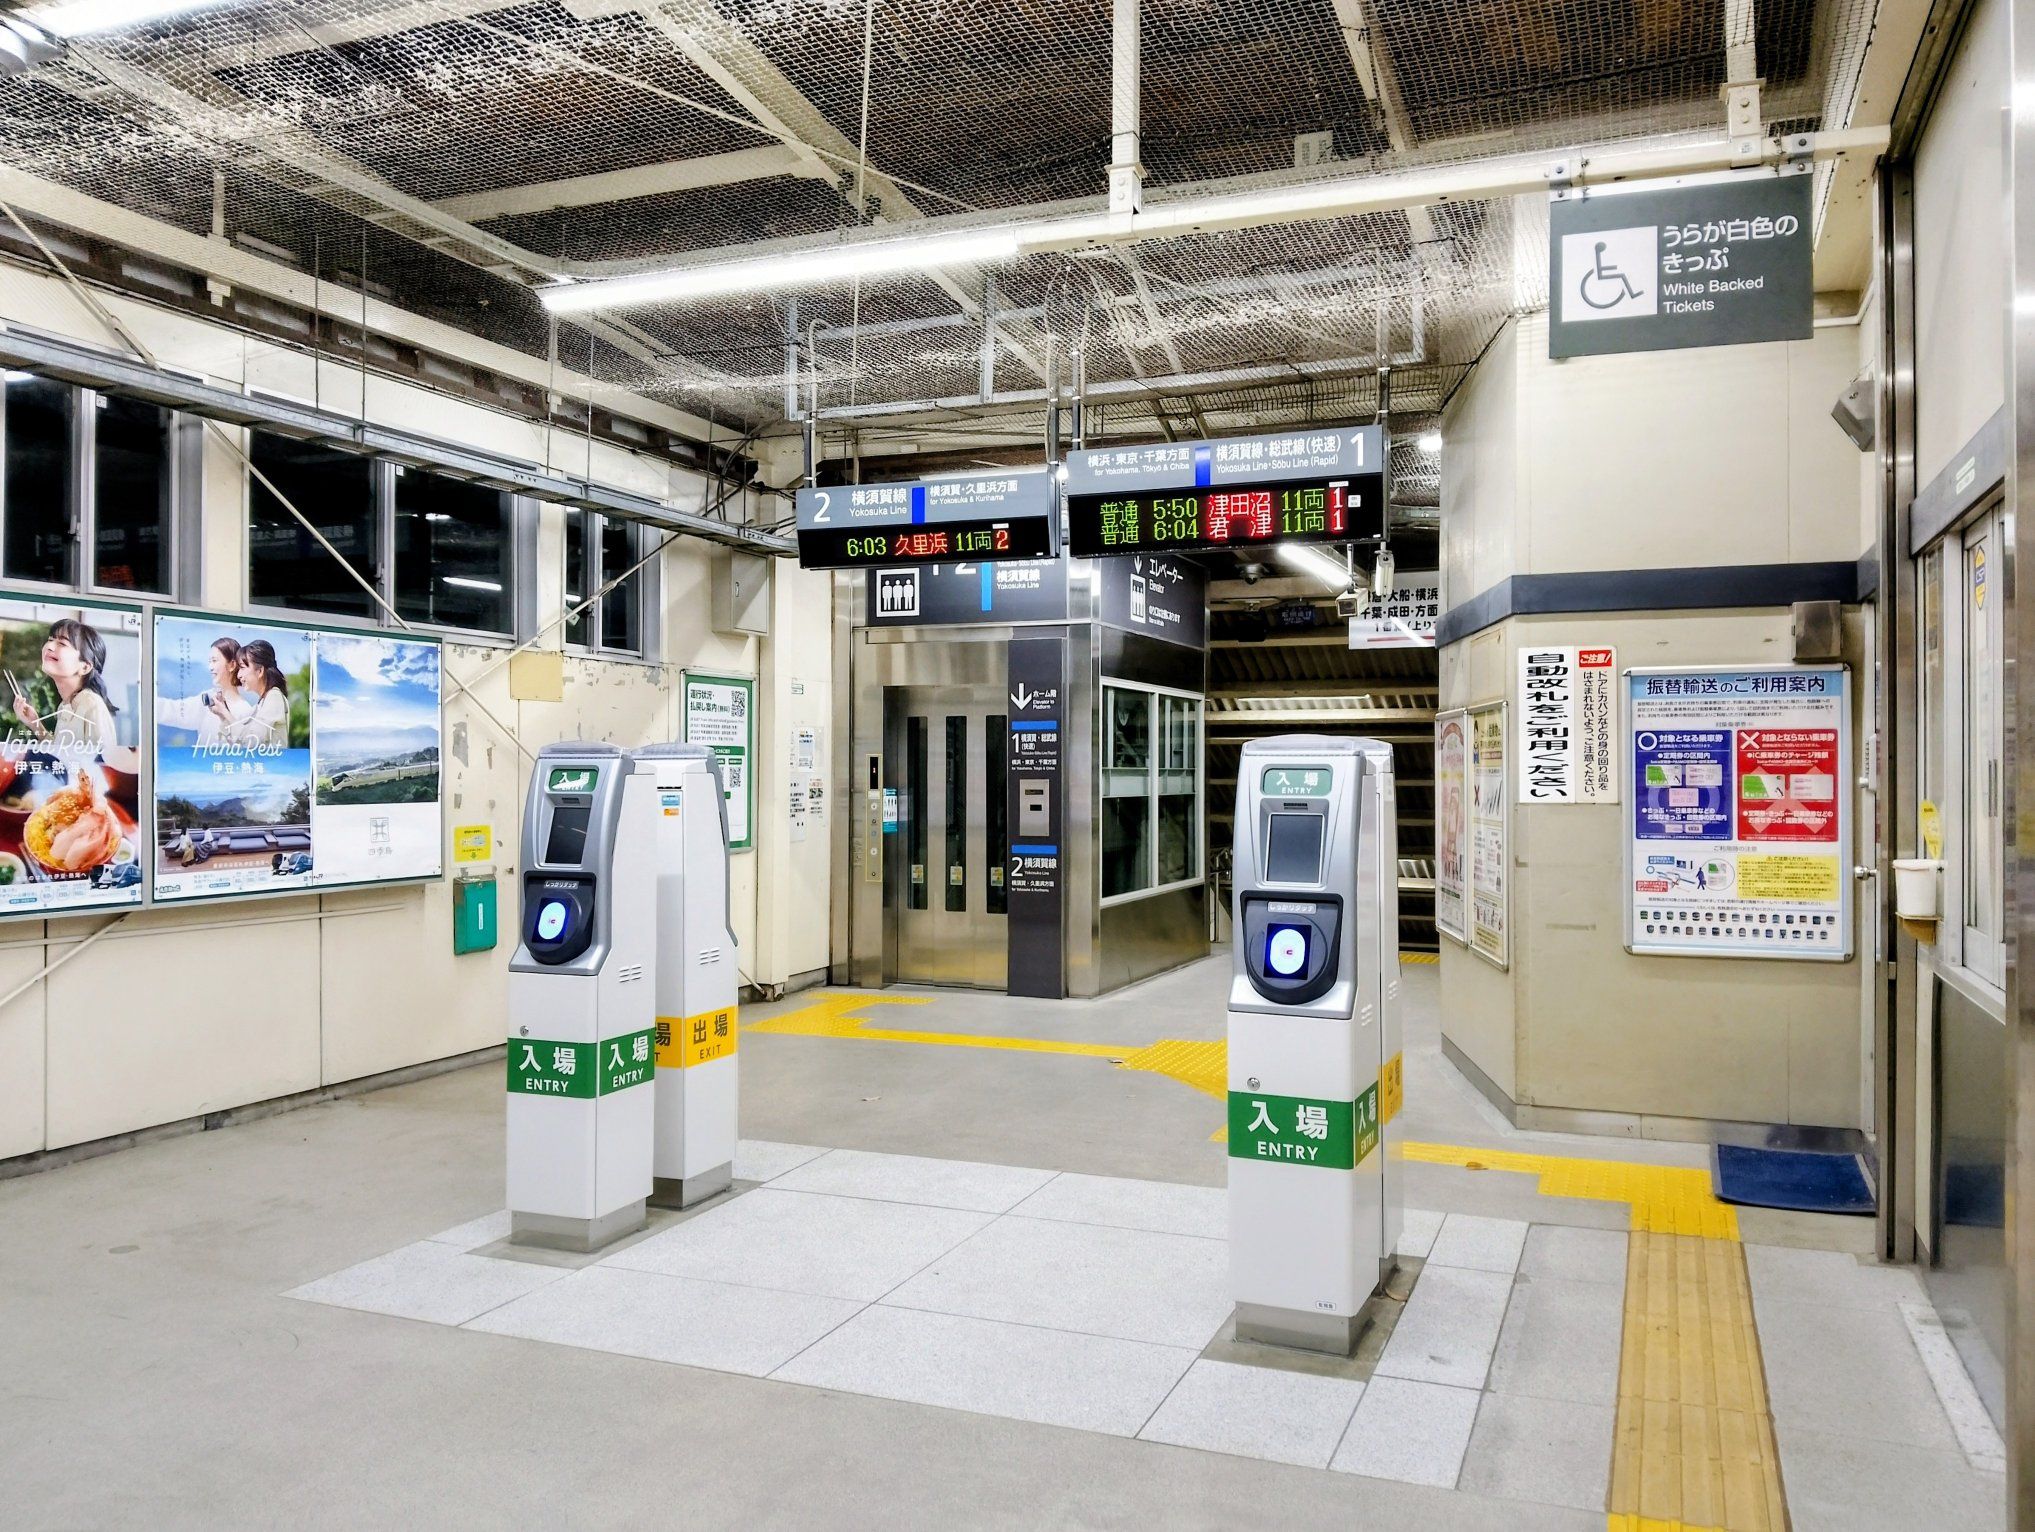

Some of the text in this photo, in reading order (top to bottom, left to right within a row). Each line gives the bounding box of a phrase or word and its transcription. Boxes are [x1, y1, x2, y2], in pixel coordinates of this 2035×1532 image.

[1663, 215, 1799, 248] うらが白色の
[1662, 247, 1729, 274] きっぷ
[1663, 275, 1763, 296] White Backed
[1663, 299, 1714, 314] Tickets
[1350, 432, 1364, 467] 1
[1094, 468, 1104, 476] for
[1170, 462, 1189, 470] Chiba
[1216, 463, 1250, 474] Yokosuka
[1293, 457, 1309, 468] Line
[1310, 454, 1339, 468] (Rapid)
[813, 492, 831, 522] 2
[851, 488, 907, 506] 横須賀線
[940, 497, 968, 505] Yokosuka
[976, 494, 1004, 502] Kurihama
[1100, 501, 1138, 524] 普通
[1153, 498, 1198, 519] 5:50
[1208, 492, 1271, 517] 津田沼
[1281, 488, 1325, 511] 11両
[1333, 487, 1343, 509] 1
[849, 506, 907, 518] Yokosuka Line
[1101, 521, 1139, 545] 普通
[1154, 519, 1199, 541] 6:04
[1282, 511, 1325, 533] 11両
[1333, 510, 1343, 530] 1
[847, 530, 1009, 557] 6:03 久里浜 11両 2
[997, 568, 1040, 582] 横須賀線
[1149, 558, 1184, 584] エレベーター
[1033, 689, 1057, 698] ホーム階
[1647, 676, 1825, 695] 振替輸送のご利用案内
[1526, 653, 1569, 797] 自動改札をご利用ください
[57, 729, 103, 757] Rest
[192, 733, 283, 758] Hana Rest
[1011, 733, 1019, 753] 1
[1276, 772, 1319, 786] 入場
[1281, 787, 1312, 795] ENTRY
[1011, 857, 1023, 877] 2
[1025, 857, 1057, 869] 横須賀線
[693, 1013, 728, 1045] 出場
[519, 1045, 576, 1075] 入場
[608, 1035, 649, 1071] 入場
[700, 1044, 721, 1060] EXIT
[526, 1078, 569, 1093] ENTRY
[613, 1068, 644, 1088] ENTRY
[1248, 1100, 1329, 1140] 入場
[1257, 1141, 1318, 1161] ENTRY
[1360, 1132, 1375, 1155] ENTRY
